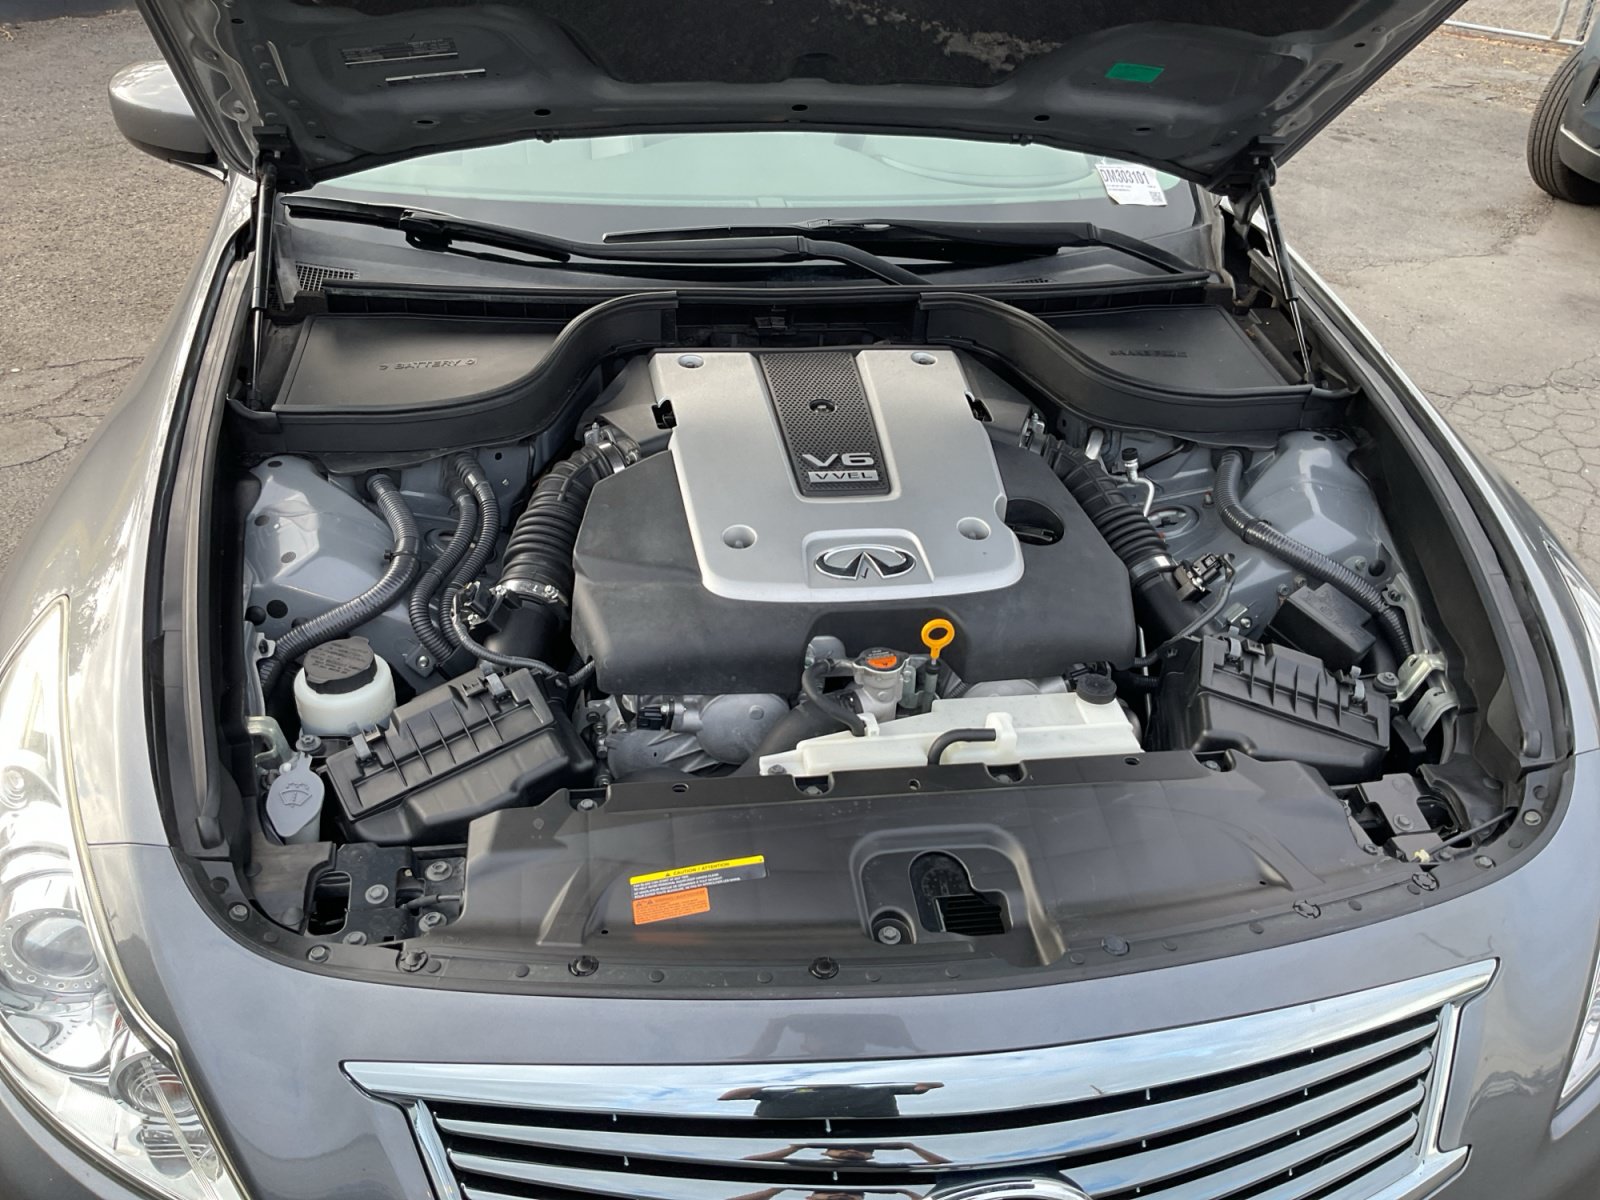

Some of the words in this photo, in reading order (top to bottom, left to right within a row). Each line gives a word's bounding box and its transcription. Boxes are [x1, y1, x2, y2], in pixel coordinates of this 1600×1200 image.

[1099, 168, 1150, 185] DM303101
[394, 359, 462, 370] BATTERY
[802, 452, 875, 467] V6
[815, 472, 873, 480] VVEL
[673, 867, 697, 876] CAUTION
[701, 862, 730, 871] ATTENTION
